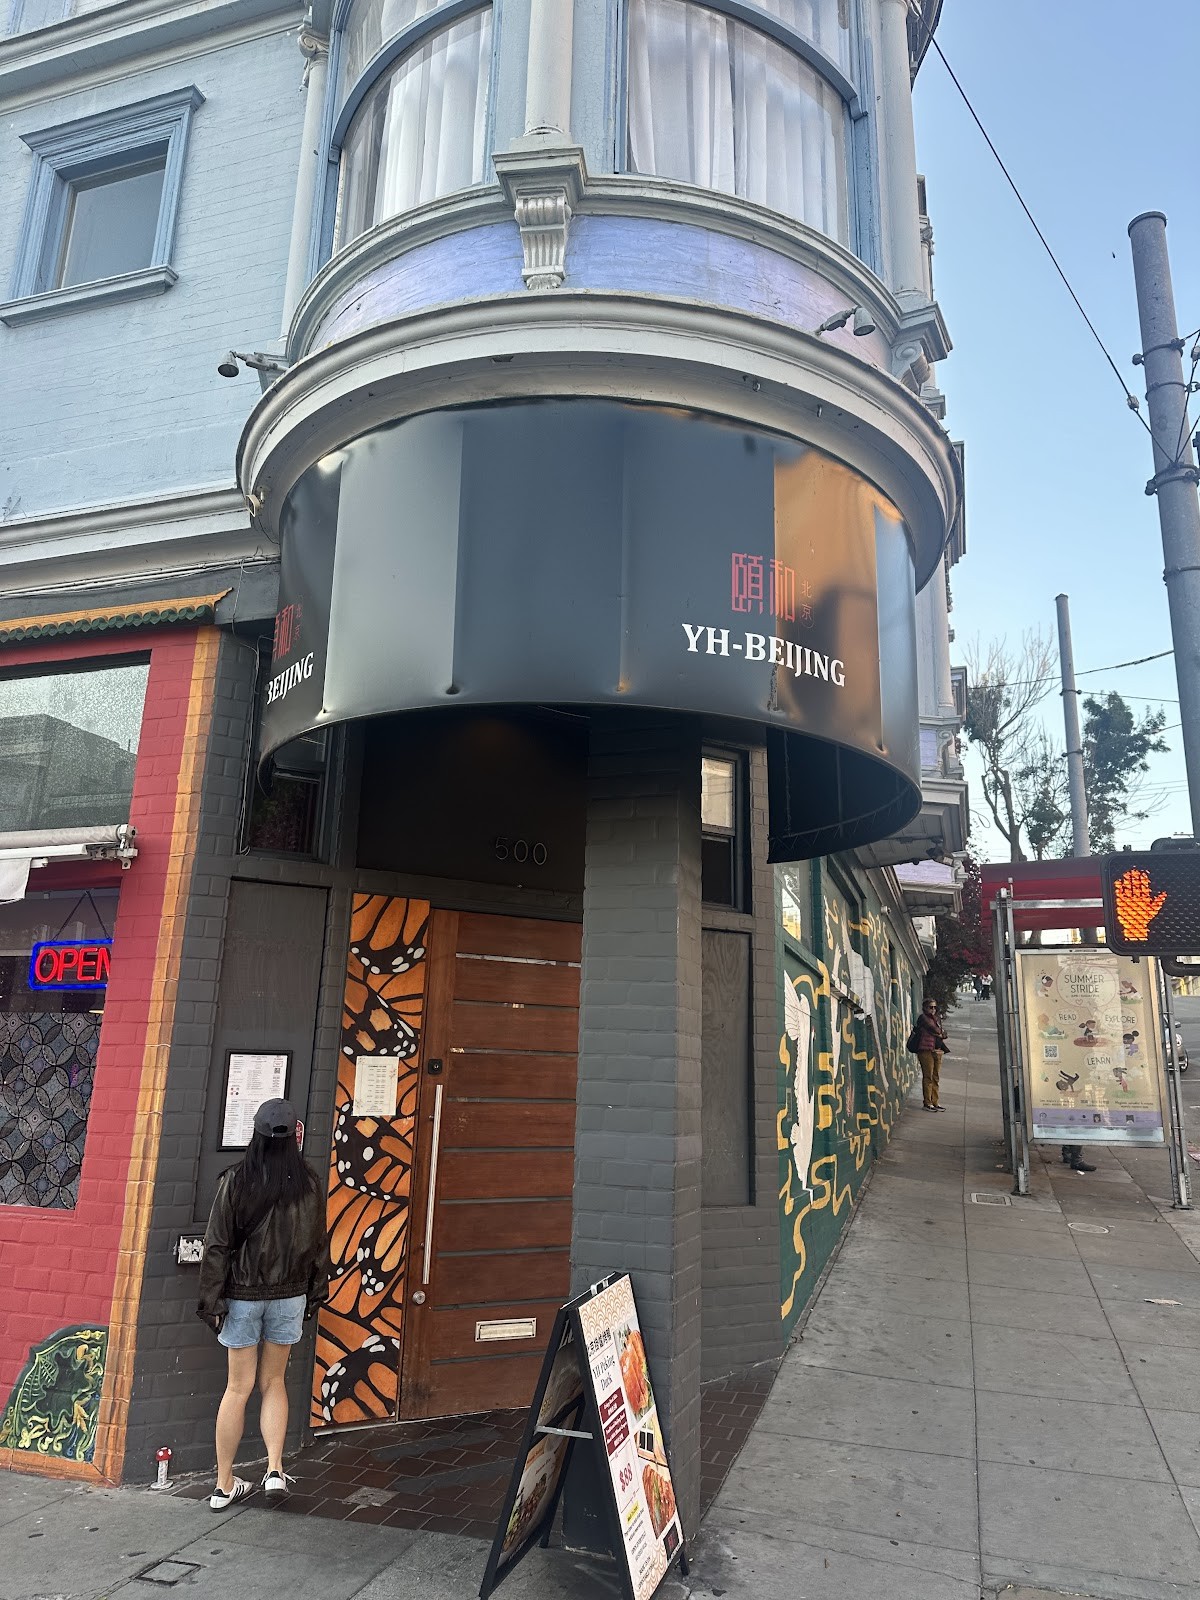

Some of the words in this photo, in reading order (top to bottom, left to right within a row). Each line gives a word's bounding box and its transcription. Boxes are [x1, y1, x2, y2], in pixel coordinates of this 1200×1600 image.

[801, 580, 814, 622] 北京
[682, 623, 846, 688] YH-BEIJING
[495, 836, 548, 866] 500
[1064, 974, 1105, 984] SUMMER
[1070, 984, 1100, 994] STRIDE
[1058, 1013, 1077, 1021] READ
[1104, 1014, 1136, 1024] EXPLORE
[1086, 1056, 1111, 1066] LEARN
[600, 1372, 613, 1391] Duck
[619, 1462, 633, 1493] $88
